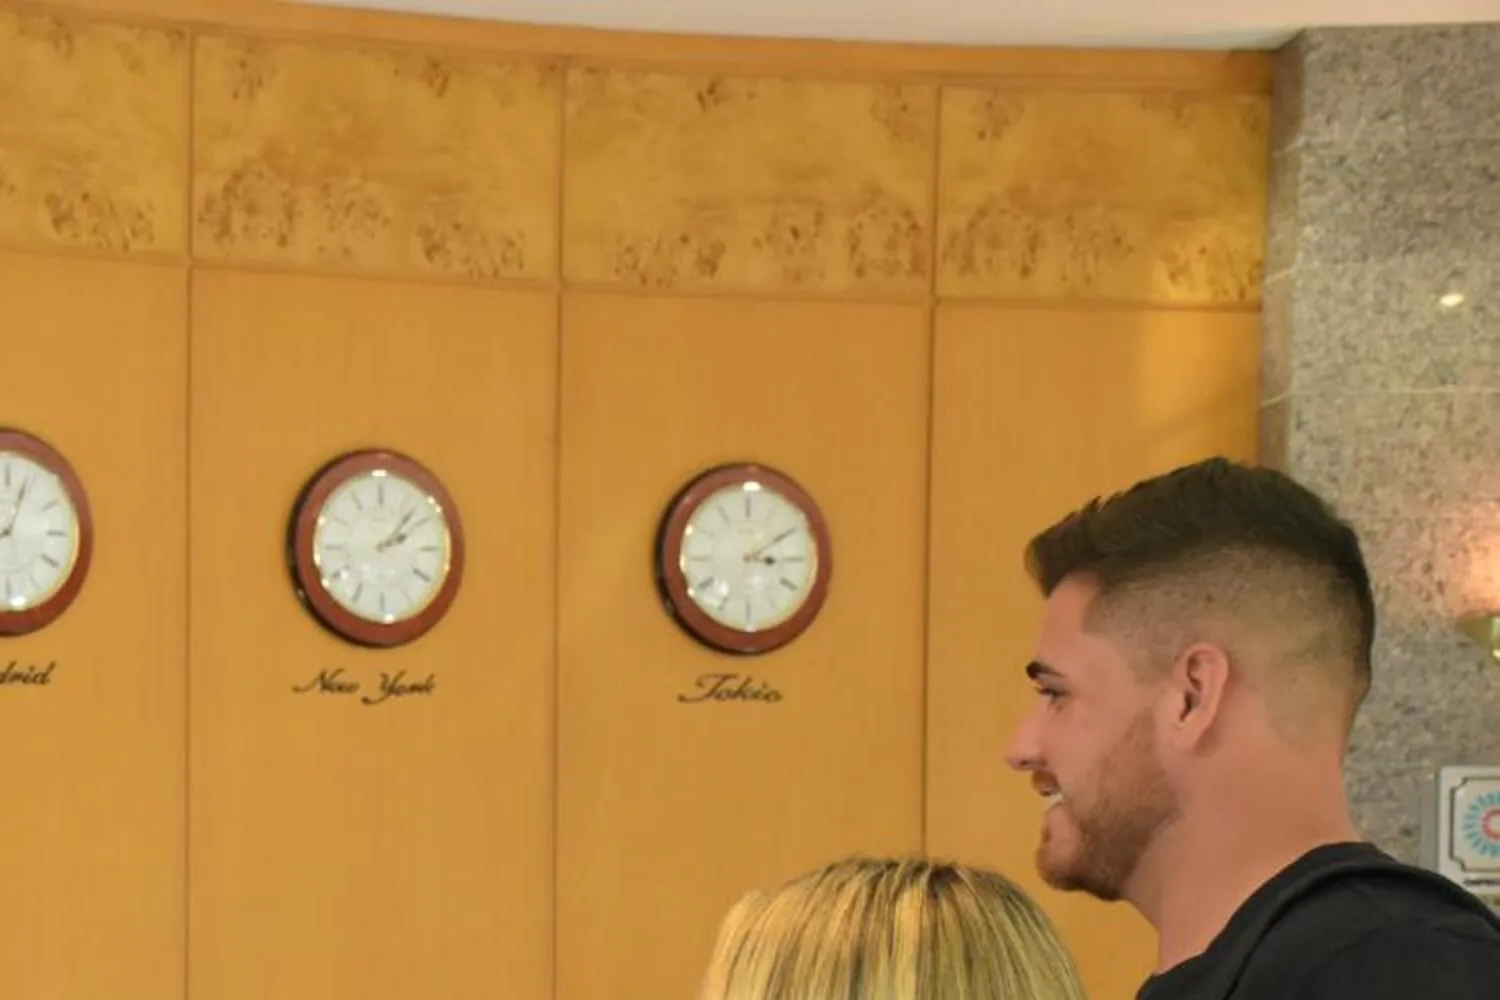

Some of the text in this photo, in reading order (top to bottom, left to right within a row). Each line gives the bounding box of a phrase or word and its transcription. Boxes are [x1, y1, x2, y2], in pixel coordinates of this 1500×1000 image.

[292, 668, 435, 705] New York
[677, 674, 783, 703] Tokio
